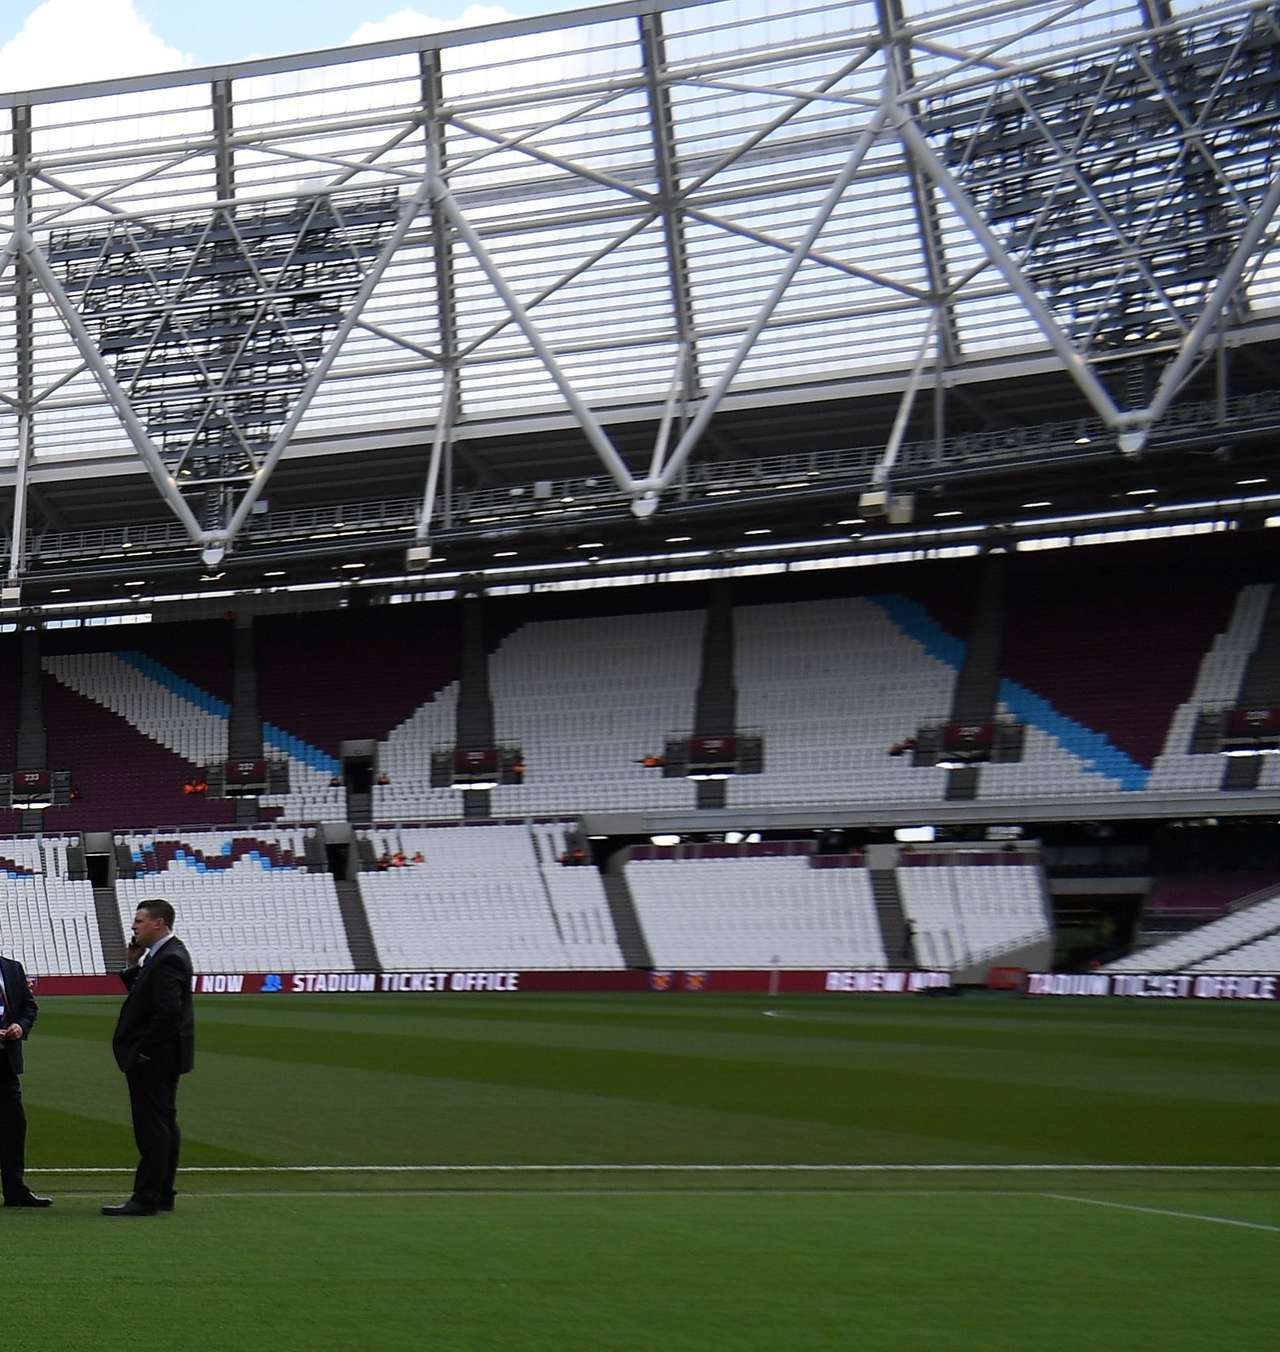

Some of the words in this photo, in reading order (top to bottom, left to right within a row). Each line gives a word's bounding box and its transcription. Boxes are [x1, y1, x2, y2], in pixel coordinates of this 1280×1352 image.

[202, 975, 244, 992] NOW
[292, 974, 375, 992] STADIUM
[381, 973, 448, 992] TICKET
[451, 973, 519, 991] OFFICE
[1194, 976, 1277, 999] OFFICE
